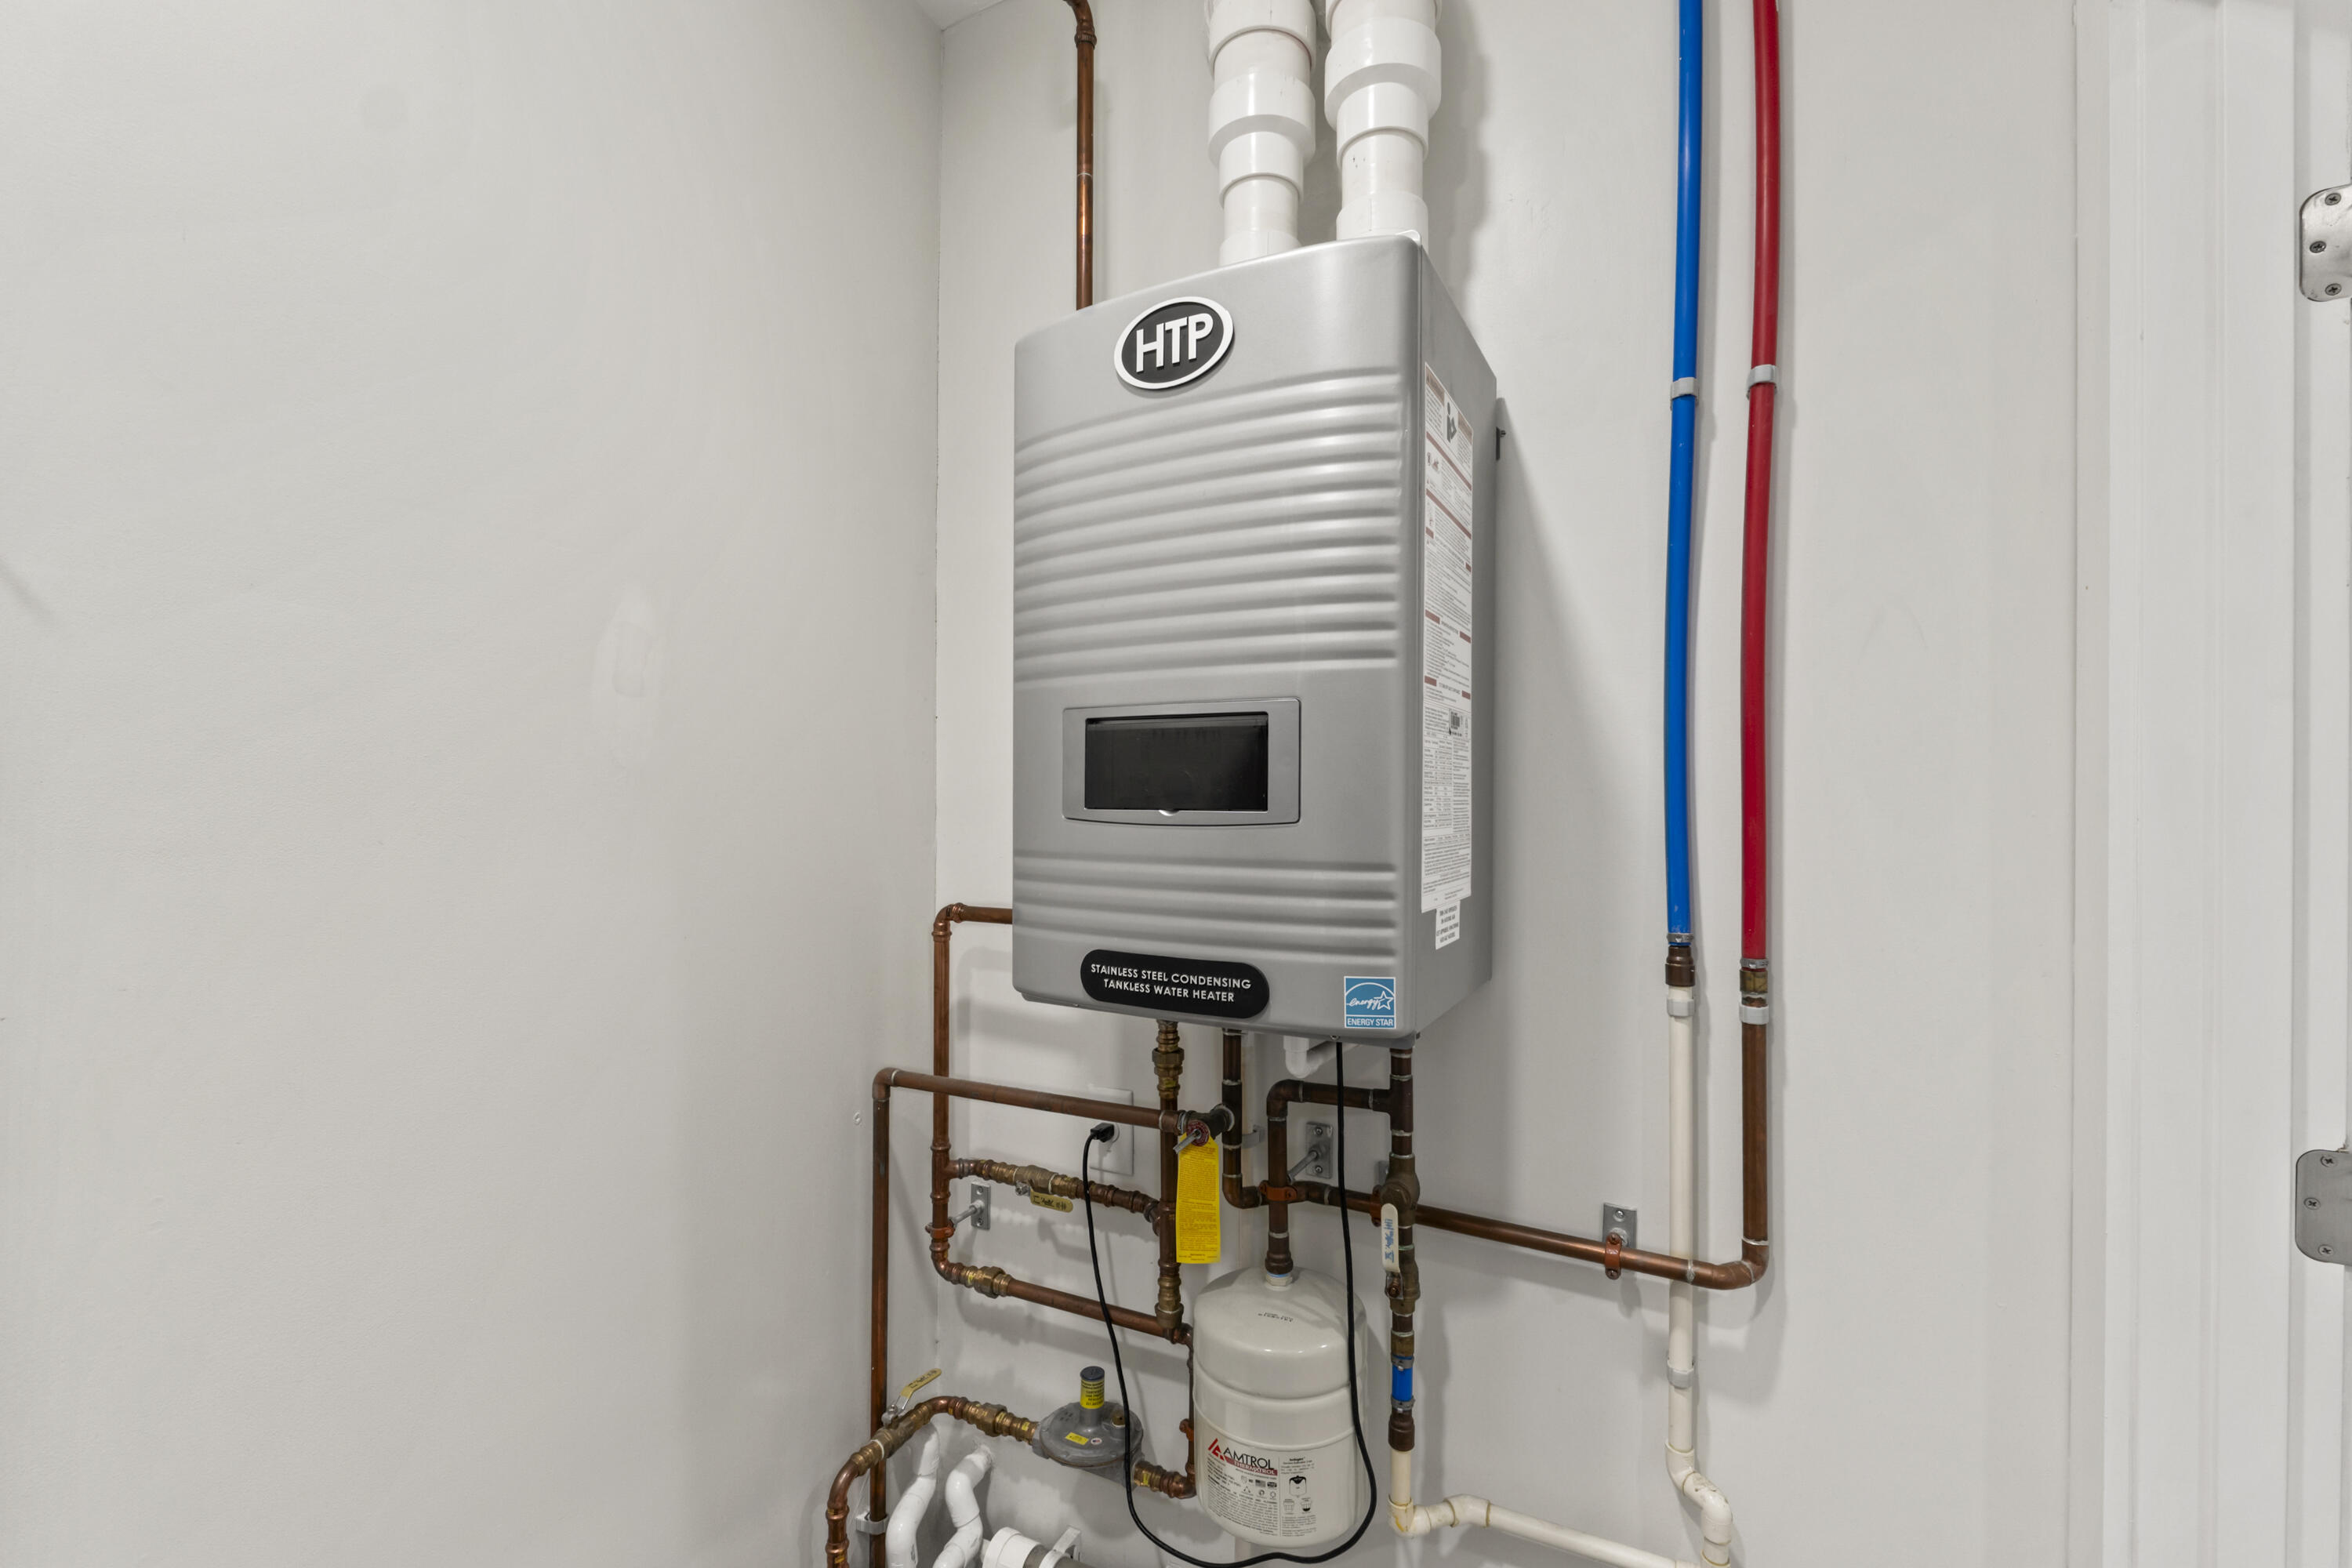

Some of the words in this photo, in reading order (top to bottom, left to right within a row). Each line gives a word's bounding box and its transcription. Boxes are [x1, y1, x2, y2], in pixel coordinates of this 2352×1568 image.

[1136, 313, 1214, 372] HTP
[1091, 964, 1138, 978] STAINLESS
[1142, 970, 1169, 982] STEEL
[1171, 974, 1251, 989] CONDENSING
[1104, 978, 1151, 993] TANKLESS
[1154, 985, 1189, 998] WATER
[1192, 990, 1234, 1002] HEATER
[1347, 1018, 1374, 1026] ENERGY
[1223, 1447, 1274, 1470] AMTROL
